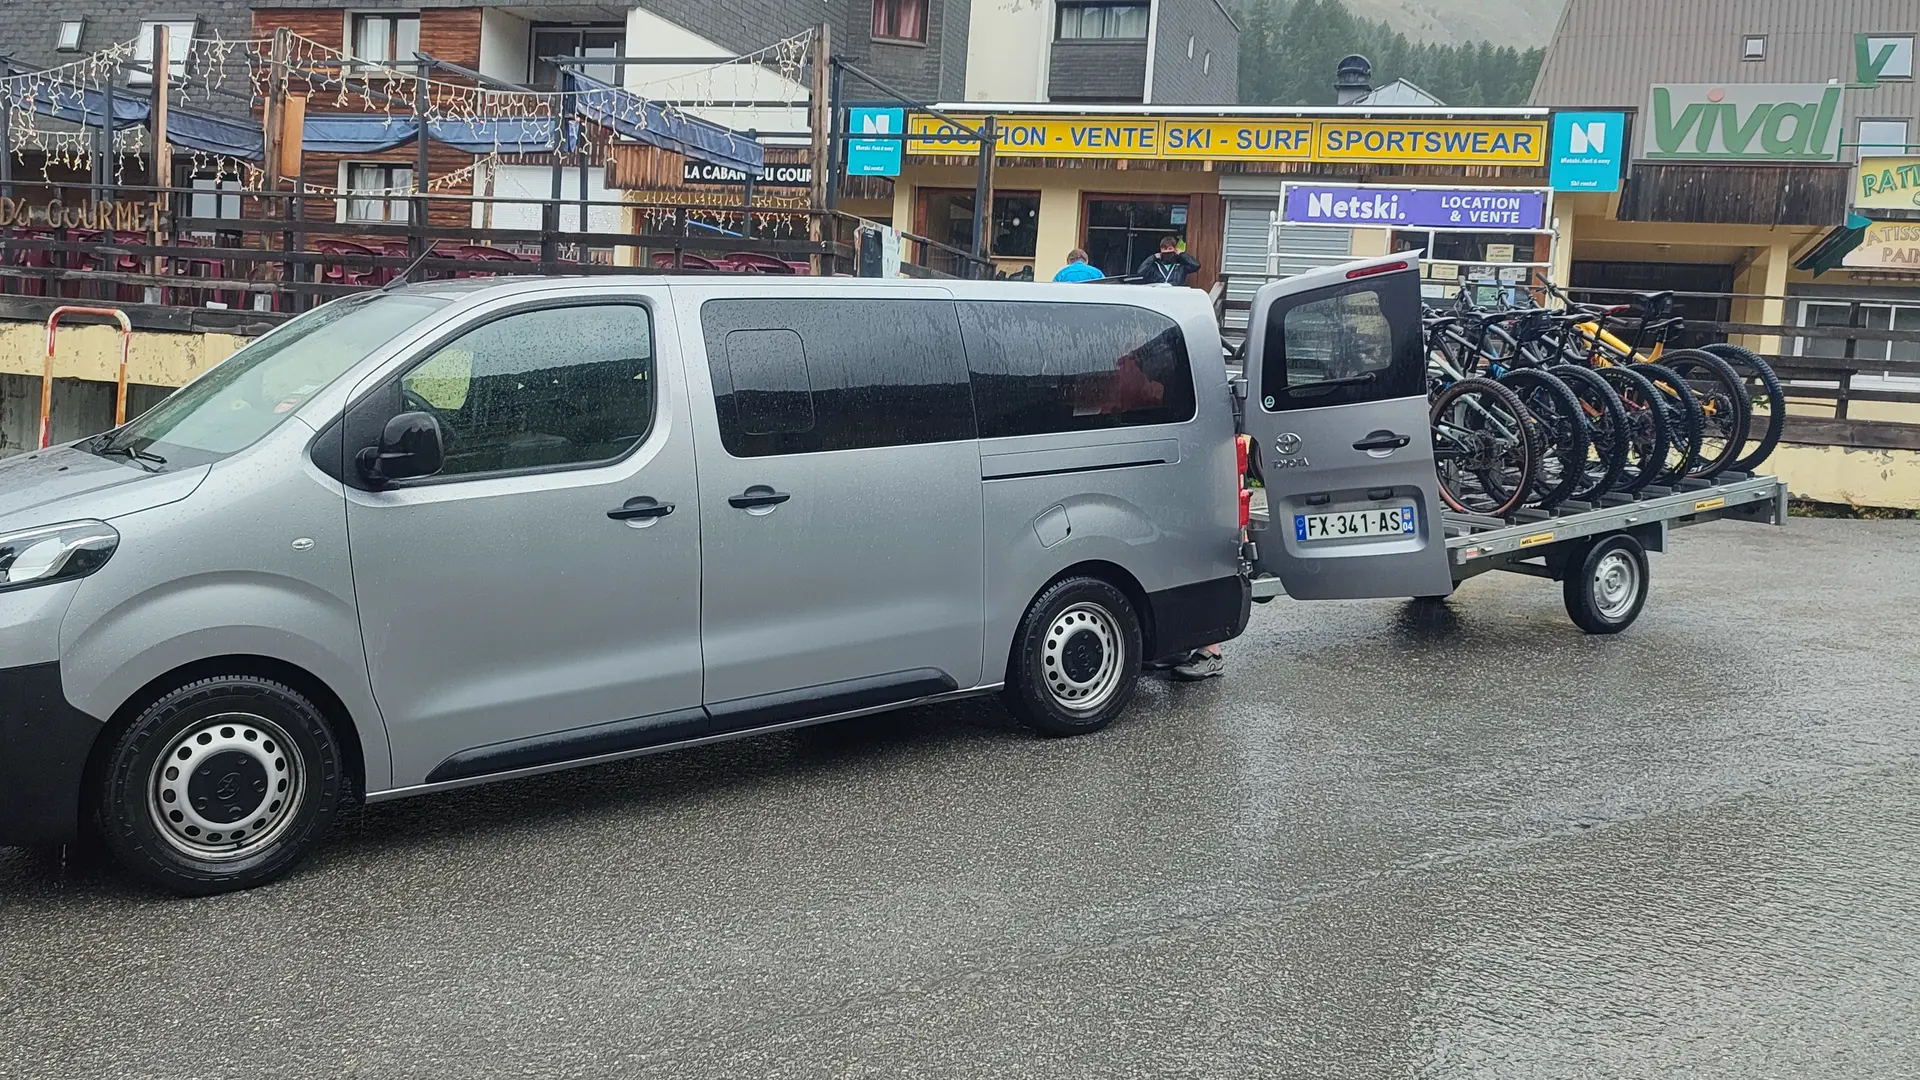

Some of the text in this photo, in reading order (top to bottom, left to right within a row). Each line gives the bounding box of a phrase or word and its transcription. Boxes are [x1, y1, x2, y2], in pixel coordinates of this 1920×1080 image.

[1653, 86, 1841, 155] Vival
[1070, 127, 1155, 148] VENTE
[1168, 128, 1211, 149] SKI
[1236, 129, 1310, 150] SURF
[1326, 130, 1532, 154] SPORTSWEAR
[684, 165, 700, 179] LA
[702, 166, 747, 181] CABAN
[1307, 192, 1406, 220] Netski.
[1441, 196, 1520, 210] LOCATION
[1450, 210, 1520, 223] & VENTE
[1272, 457, 1310, 469] TOYOTA
[1307, 511, 1401, 537] FX-341-AS
[1402, 521, 1414, 531] 04
